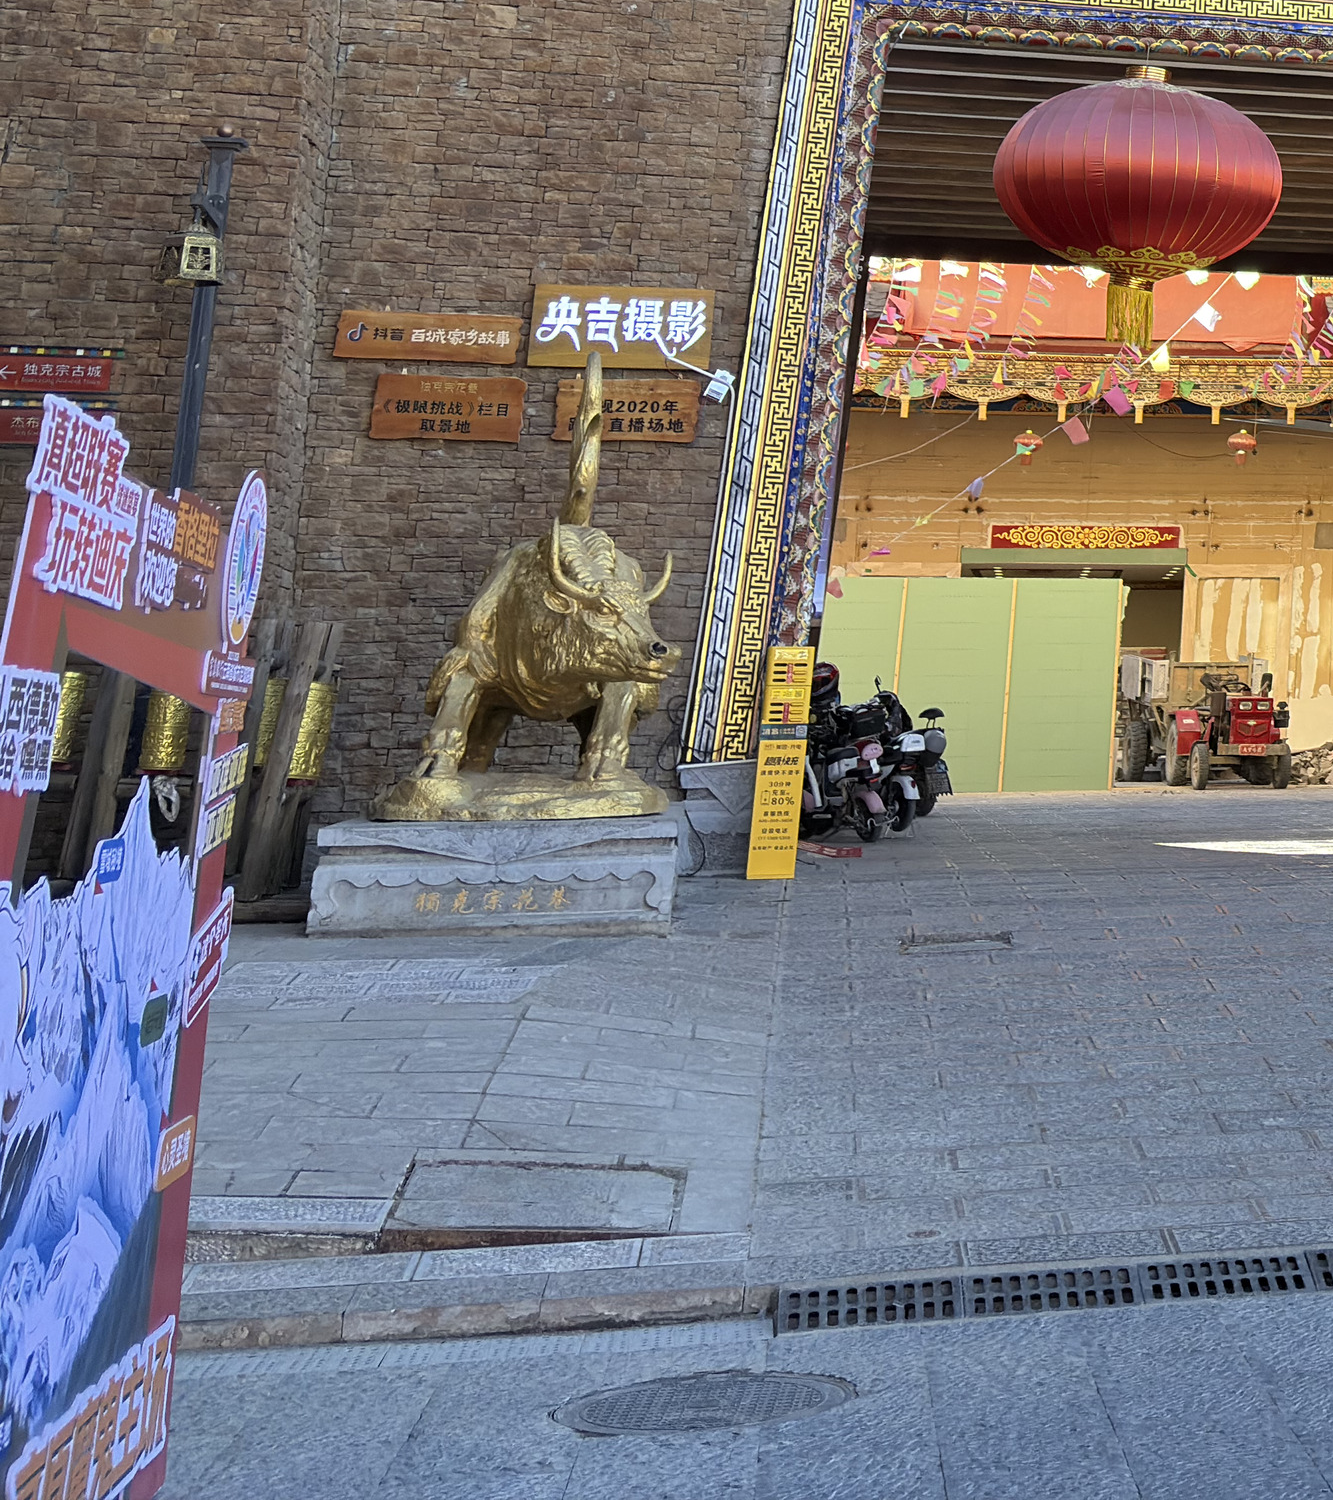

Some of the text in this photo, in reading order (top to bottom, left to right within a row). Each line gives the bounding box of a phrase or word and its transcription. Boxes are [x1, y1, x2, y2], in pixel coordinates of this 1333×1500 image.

[535, 296, 707, 357] 央吉摄影
[373, 326, 510, 348] 抖音 百城家乡故事
[23, 363, 102, 378] 独克宗古城
[381, 399, 510, 417] 《极限挑战》栏目
[577, 398, 679, 415] 视2020年
[419, 419, 471, 434] 取景地
[568, 417, 685, 433] 直播场地
[42, 501, 134, 604] 玩转迪庆
[771, 797, 795, 805] 80%
